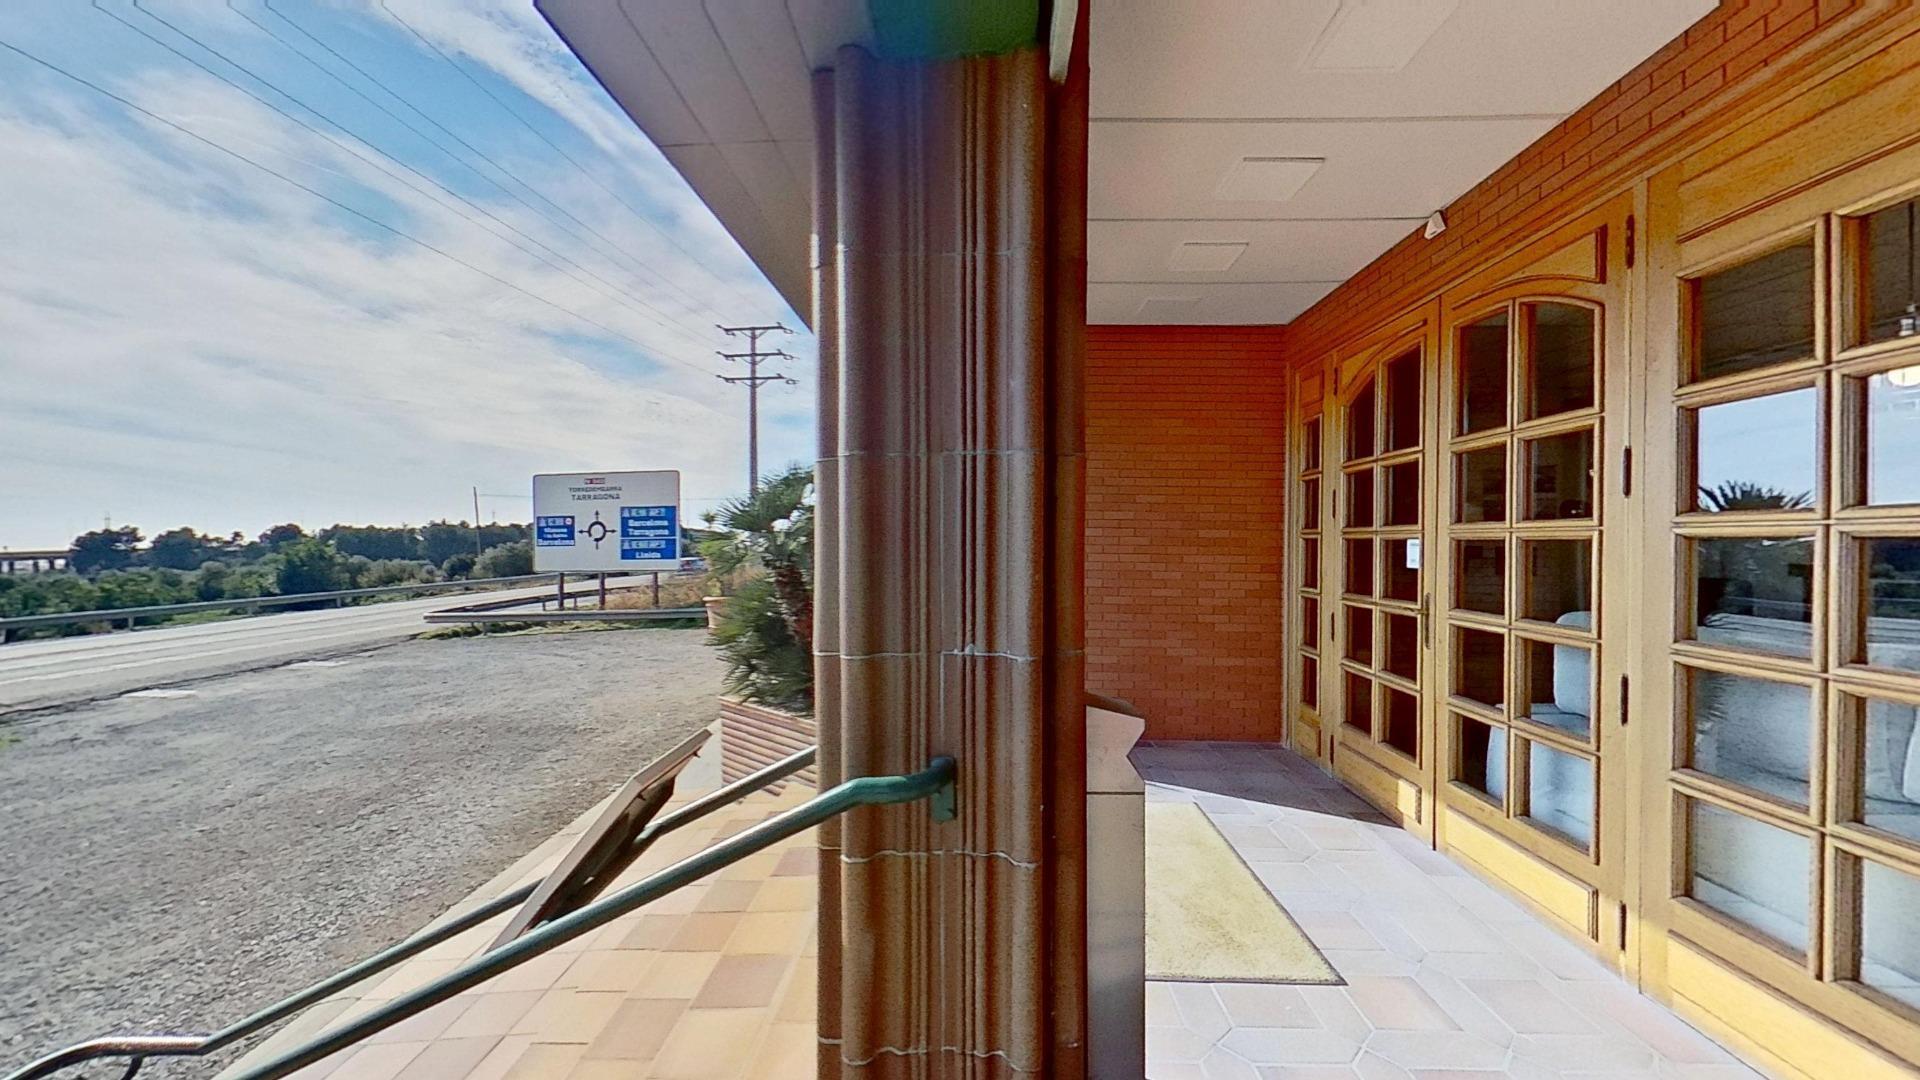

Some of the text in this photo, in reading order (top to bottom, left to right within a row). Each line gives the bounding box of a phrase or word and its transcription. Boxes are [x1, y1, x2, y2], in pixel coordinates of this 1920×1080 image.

[571, 493, 621, 501] TARRAGONA
[628, 519, 669, 527] Barcelona
[627, 528, 669, 537] Tarragona
